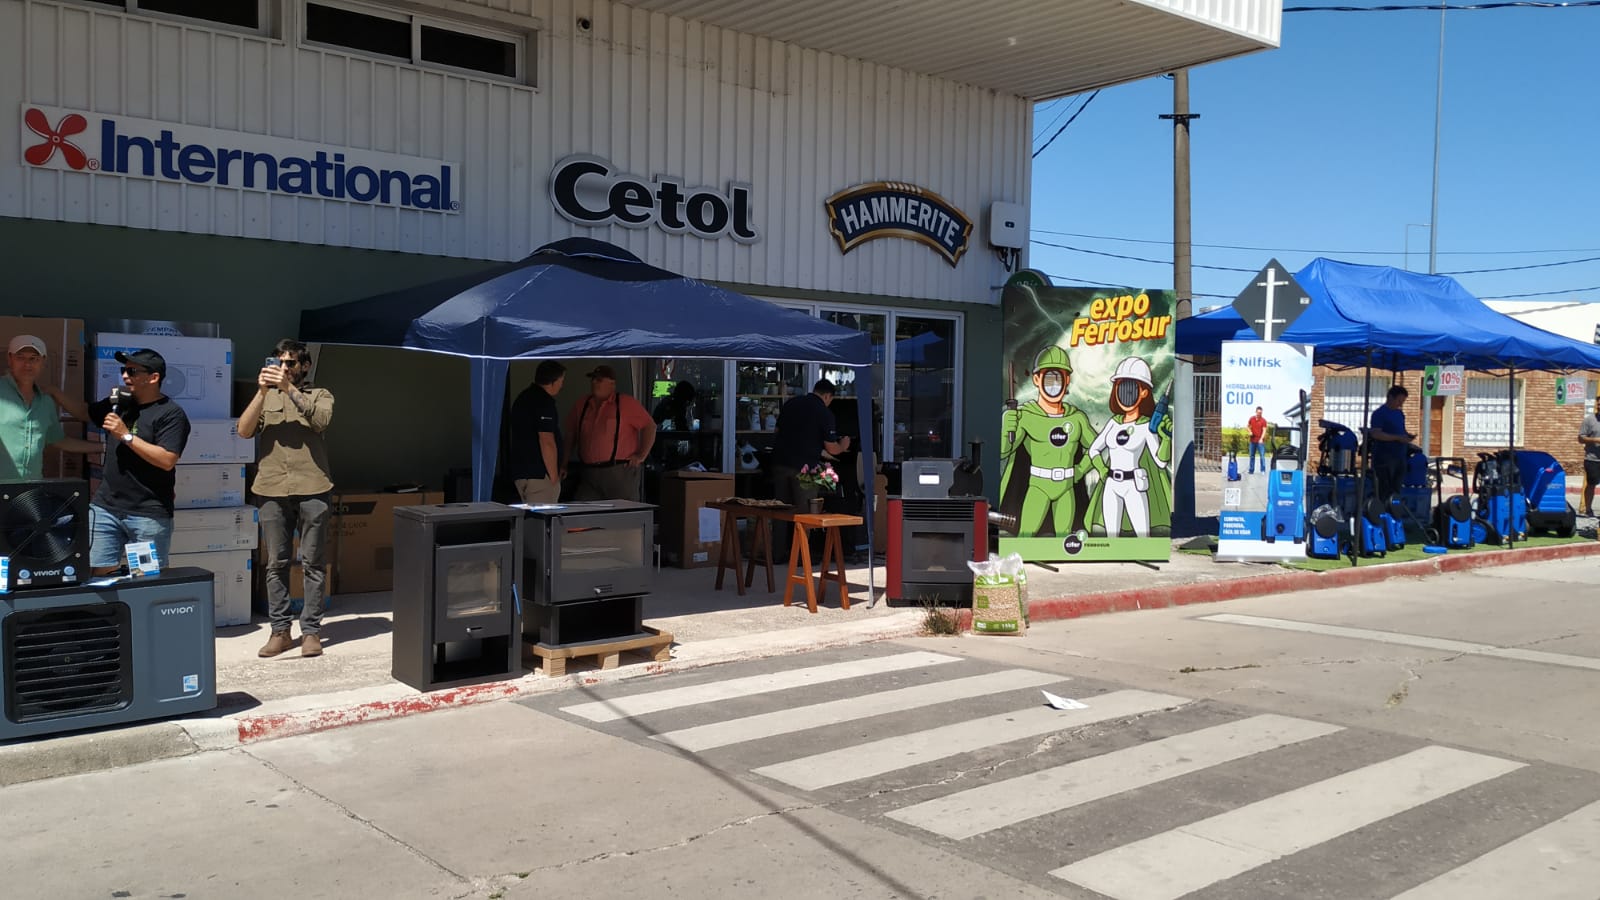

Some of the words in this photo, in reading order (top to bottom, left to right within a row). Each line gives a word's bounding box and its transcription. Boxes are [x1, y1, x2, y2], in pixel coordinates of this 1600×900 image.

[101, 118, 451, 211] International
[551, 160, 756, 240] Cetol
[840, 197, 962, 249] HAMMERITE
[1090, 293, 1150, 321] expo
[1070, 314, 1172, 347] Ferrosur
[1239, 357, 1282, 368] Nilfisk
[1441, 372, 1460, 385] 10%
[161, 606, 193, 615] VIVION
